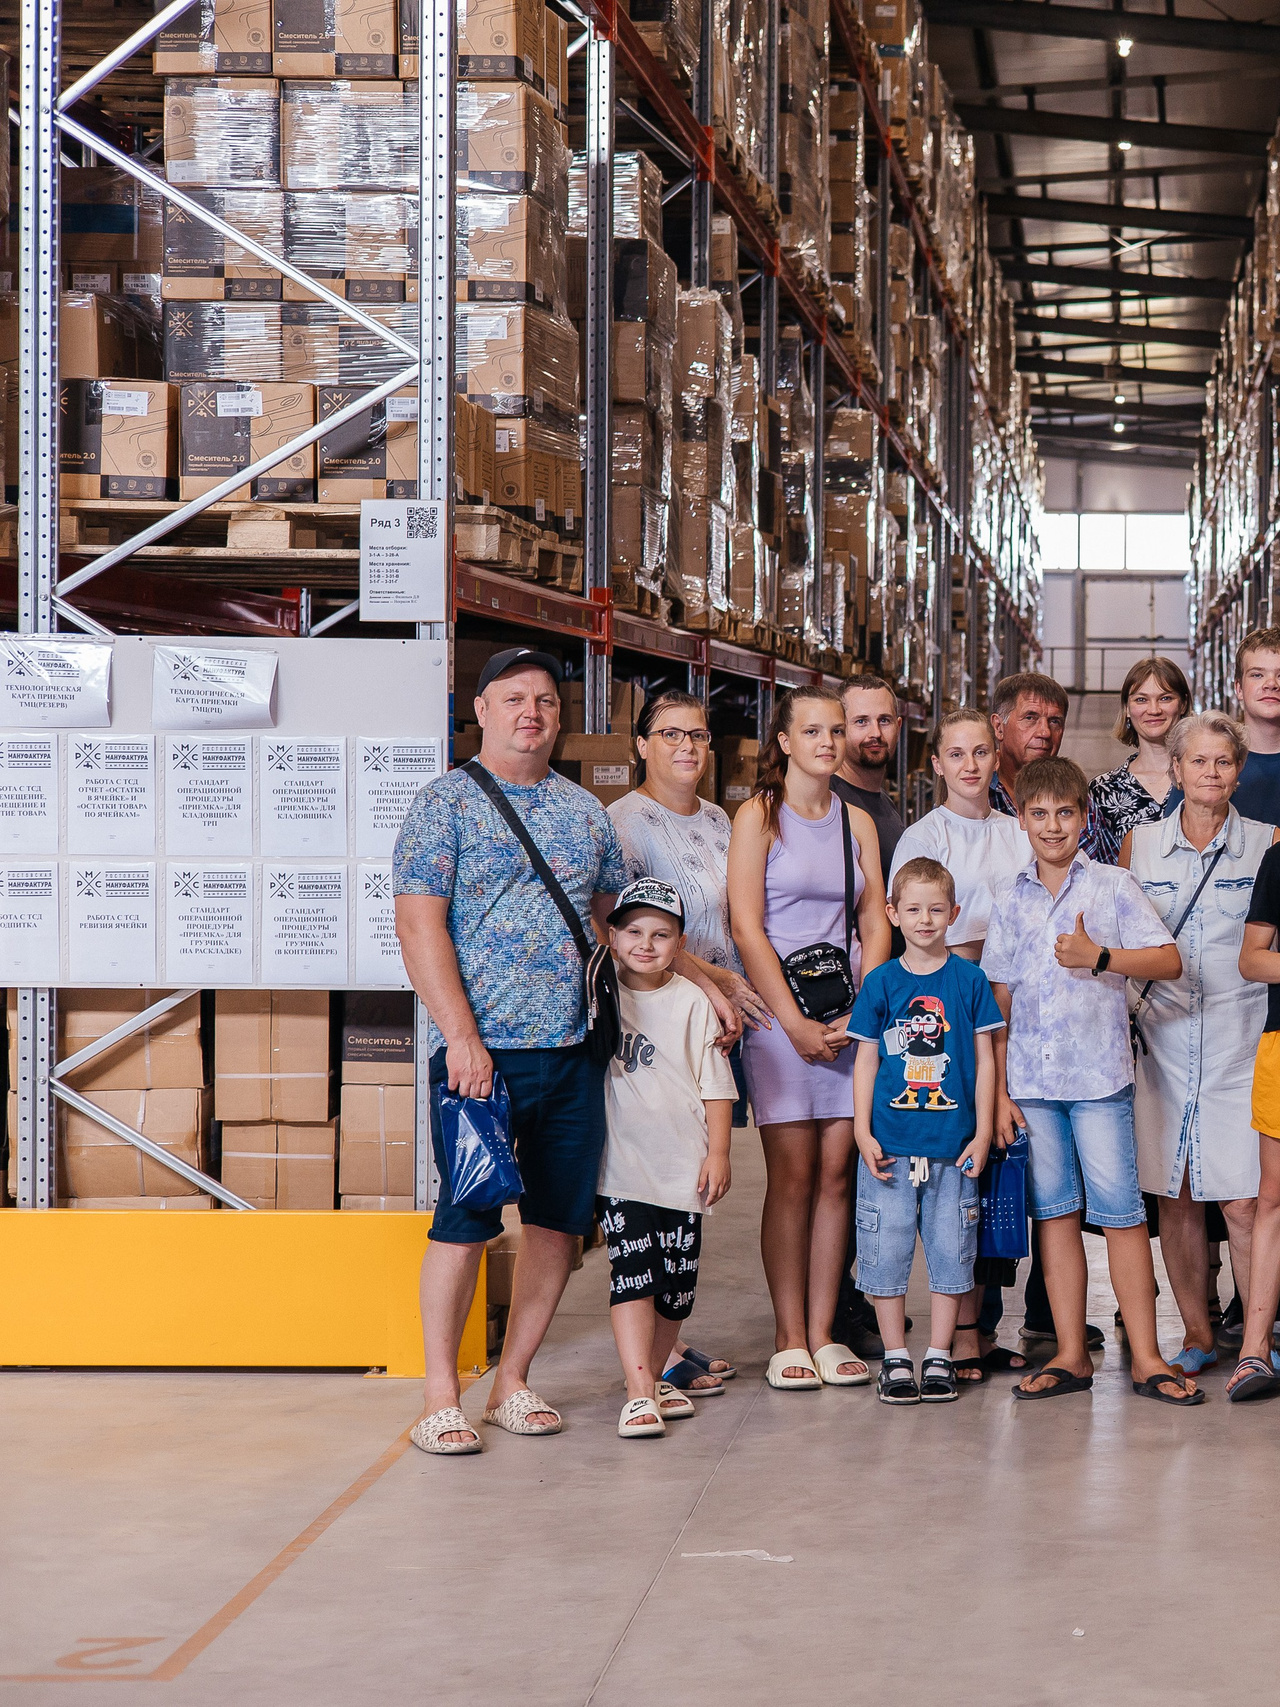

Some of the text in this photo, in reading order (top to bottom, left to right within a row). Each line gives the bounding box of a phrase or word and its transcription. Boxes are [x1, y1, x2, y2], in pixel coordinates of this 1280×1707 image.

[169, 370, 207, 378] Смеситель
[188, 454, 231, 462] Смеситель
[323, 457, 381, 465] Смеситель 2.0
[370, 518, 401, 529] Ряд 3
[169, 688, 245, 698] ТЕХНОЛОГИЧЕСКАЯ
[19, 701, 68, 709] ТМЦ(РЕЗЕРВ)
[201, 698, 238, 706] ПРИЕМКИ
[191, 706, 223, 714] ТМЦ(РЦ)
[272, 787, 337, 795] ОПЕРАЦИОННОЙ
[178, 914, 243, 922] ОПЕРАЦИОННОЙ
[273, 915, 338, 923] ОПЕРАЦИОННОЙ
[179, 947, 193, 955] (НА
[274, 947, 338, 956] (В КОНТЕЙНЕРЕ)
[348, 1036, 402, 1046] Смеситель
[907, 1065, 936, 1081] SURF
[621, 1233, 652, 1257] Angel
[616, 1268, 653, 1294] Angel
